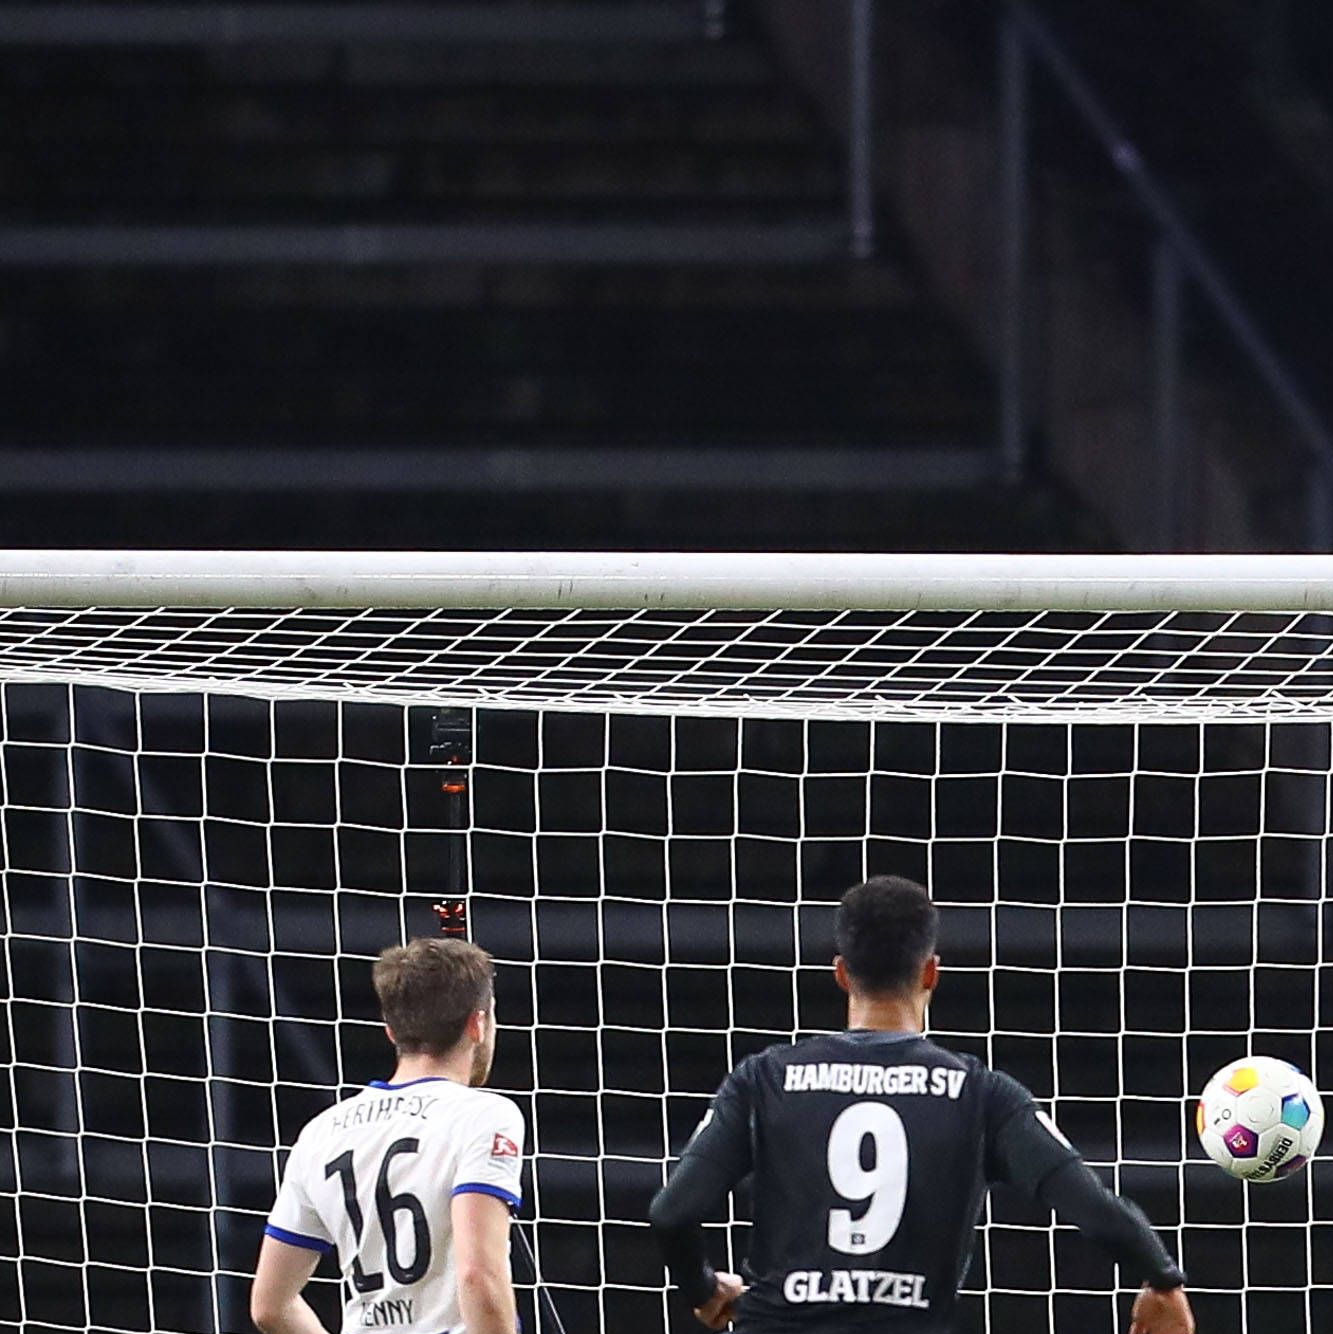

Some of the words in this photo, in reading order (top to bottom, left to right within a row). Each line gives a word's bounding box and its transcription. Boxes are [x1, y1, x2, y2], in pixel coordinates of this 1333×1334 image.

[784, 1063, 927, 1094] HAMBURGER
[930, 1067, 966, 1099] SV
[325, 1137, 431, 1292] 16
[827, 1101, 909, 1255] 9
[784, 1270, 930, 1308] GLATZEL
